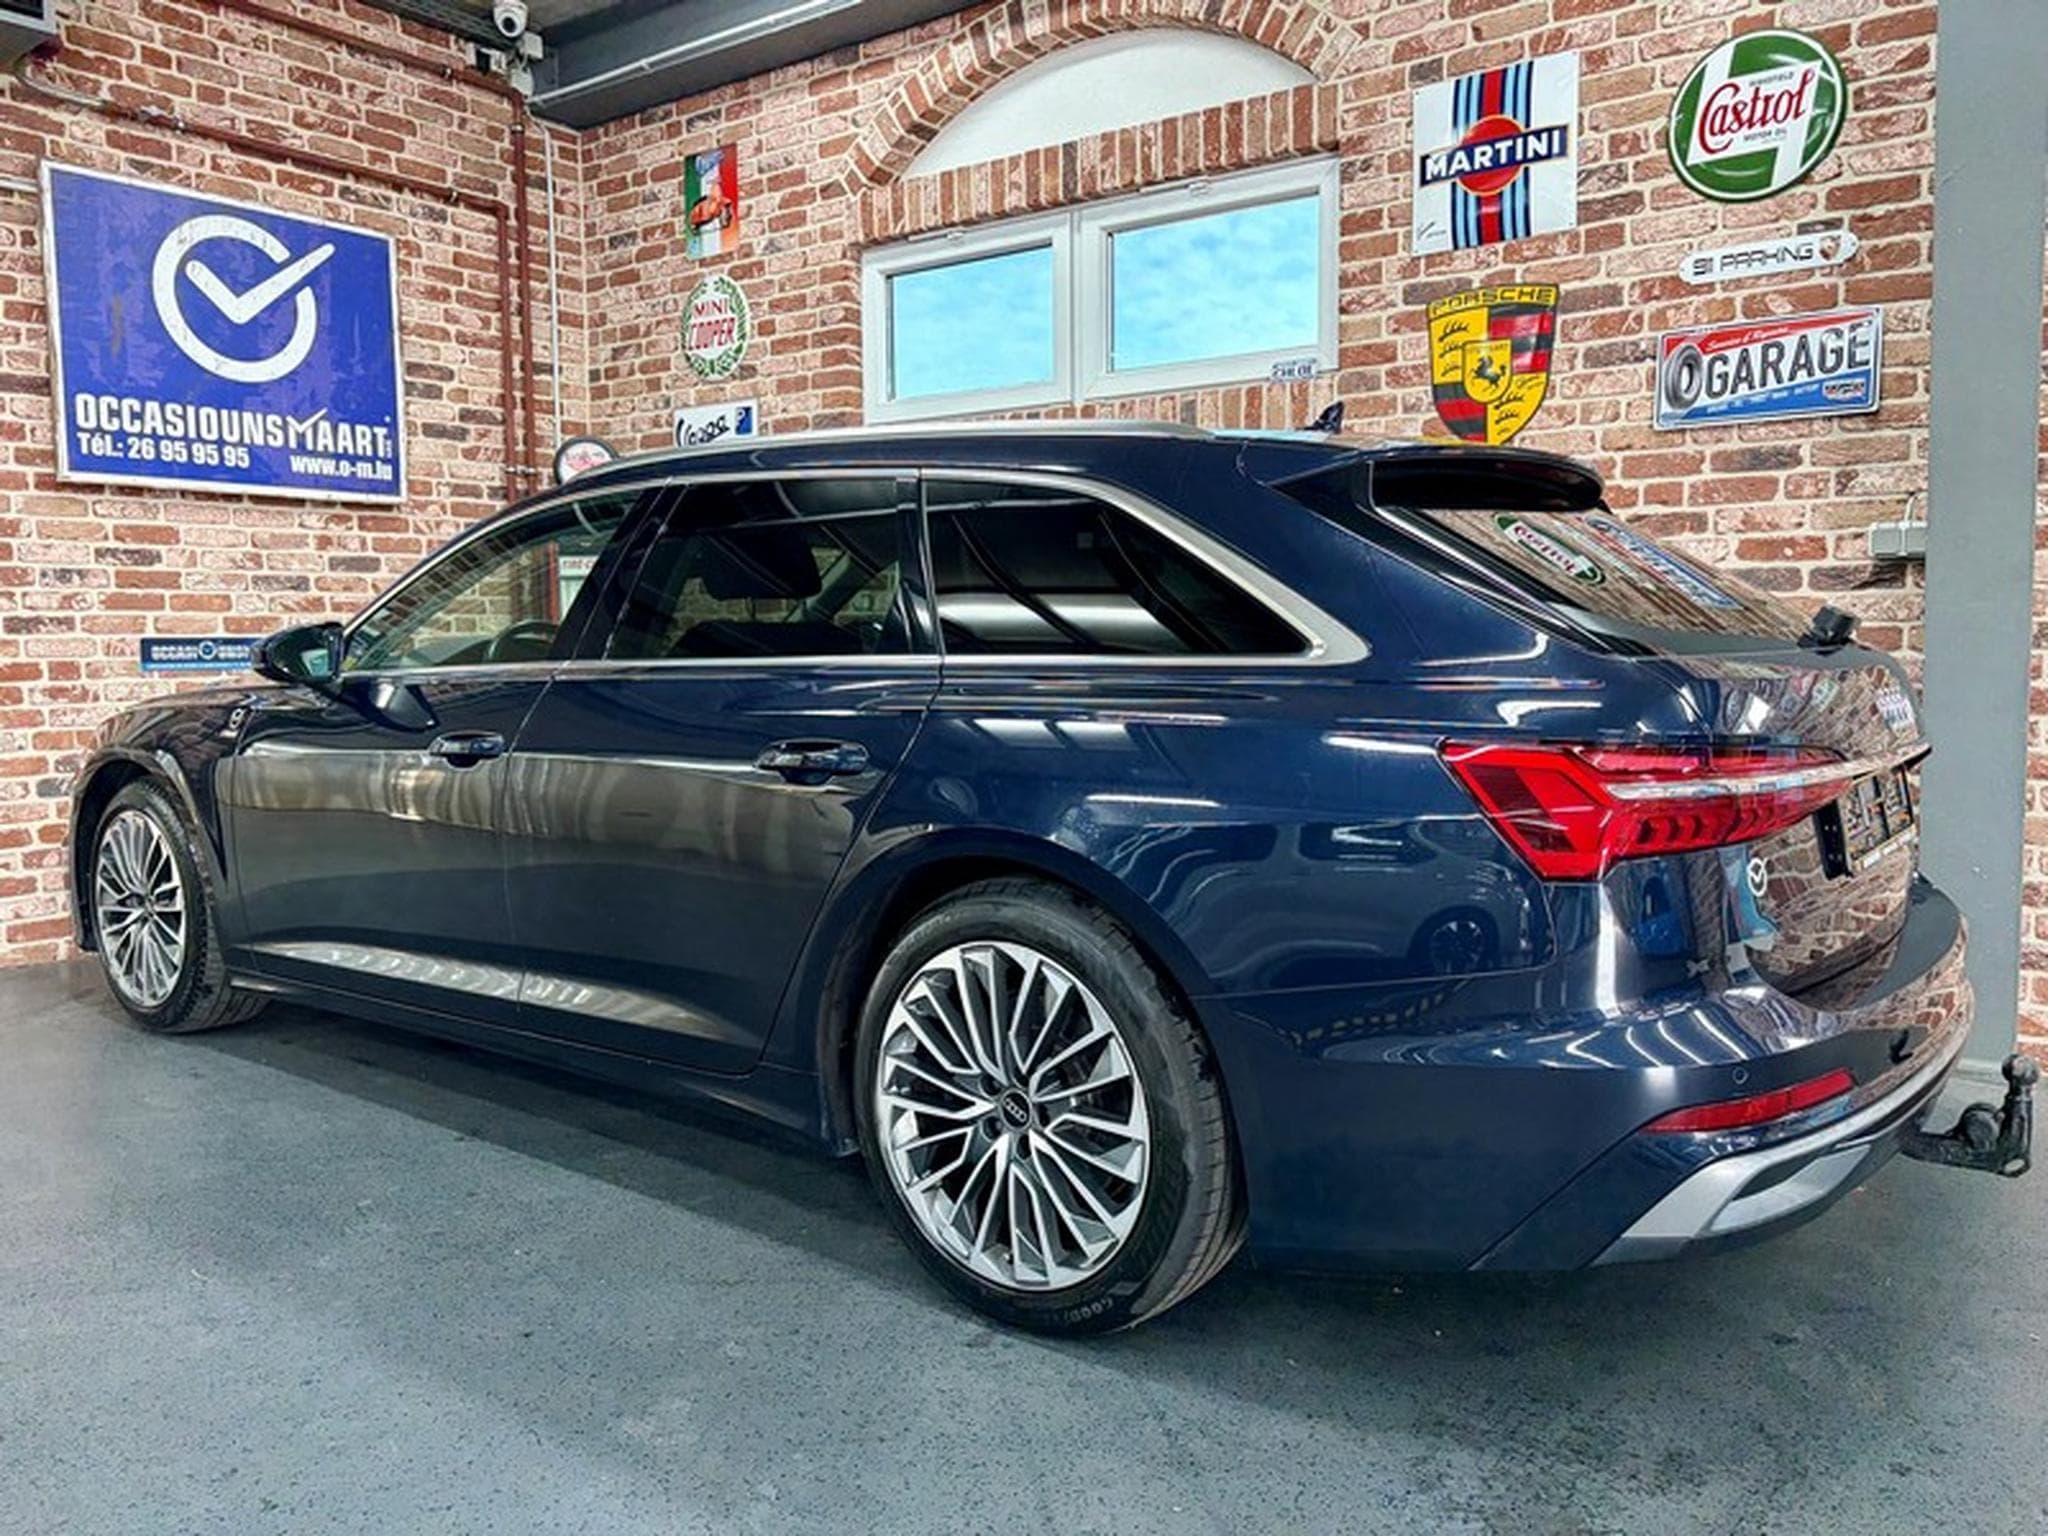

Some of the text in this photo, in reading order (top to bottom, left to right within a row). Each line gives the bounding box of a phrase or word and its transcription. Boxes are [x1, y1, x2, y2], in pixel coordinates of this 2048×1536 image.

[1698, 68, 1815, 155] Castrol
[1424, 129, 1561, 181] MARTINI
[1720, 242, 1814, 272] PARKING
[693, 298, 729, 318] MINI
[1432, 287, 1553, 316] PORSCHE
[688, 317, 736, 351] COOPER
[1705, 319, 1873, 400] GARAGE
[127, 436, 155, 460] 26
[160, 439, 188, 463] 95
[192, 442, 220, 466] 95
[224, 446, 250, 469] 95
[289, 454, 393, 481] www.o-m.lu
